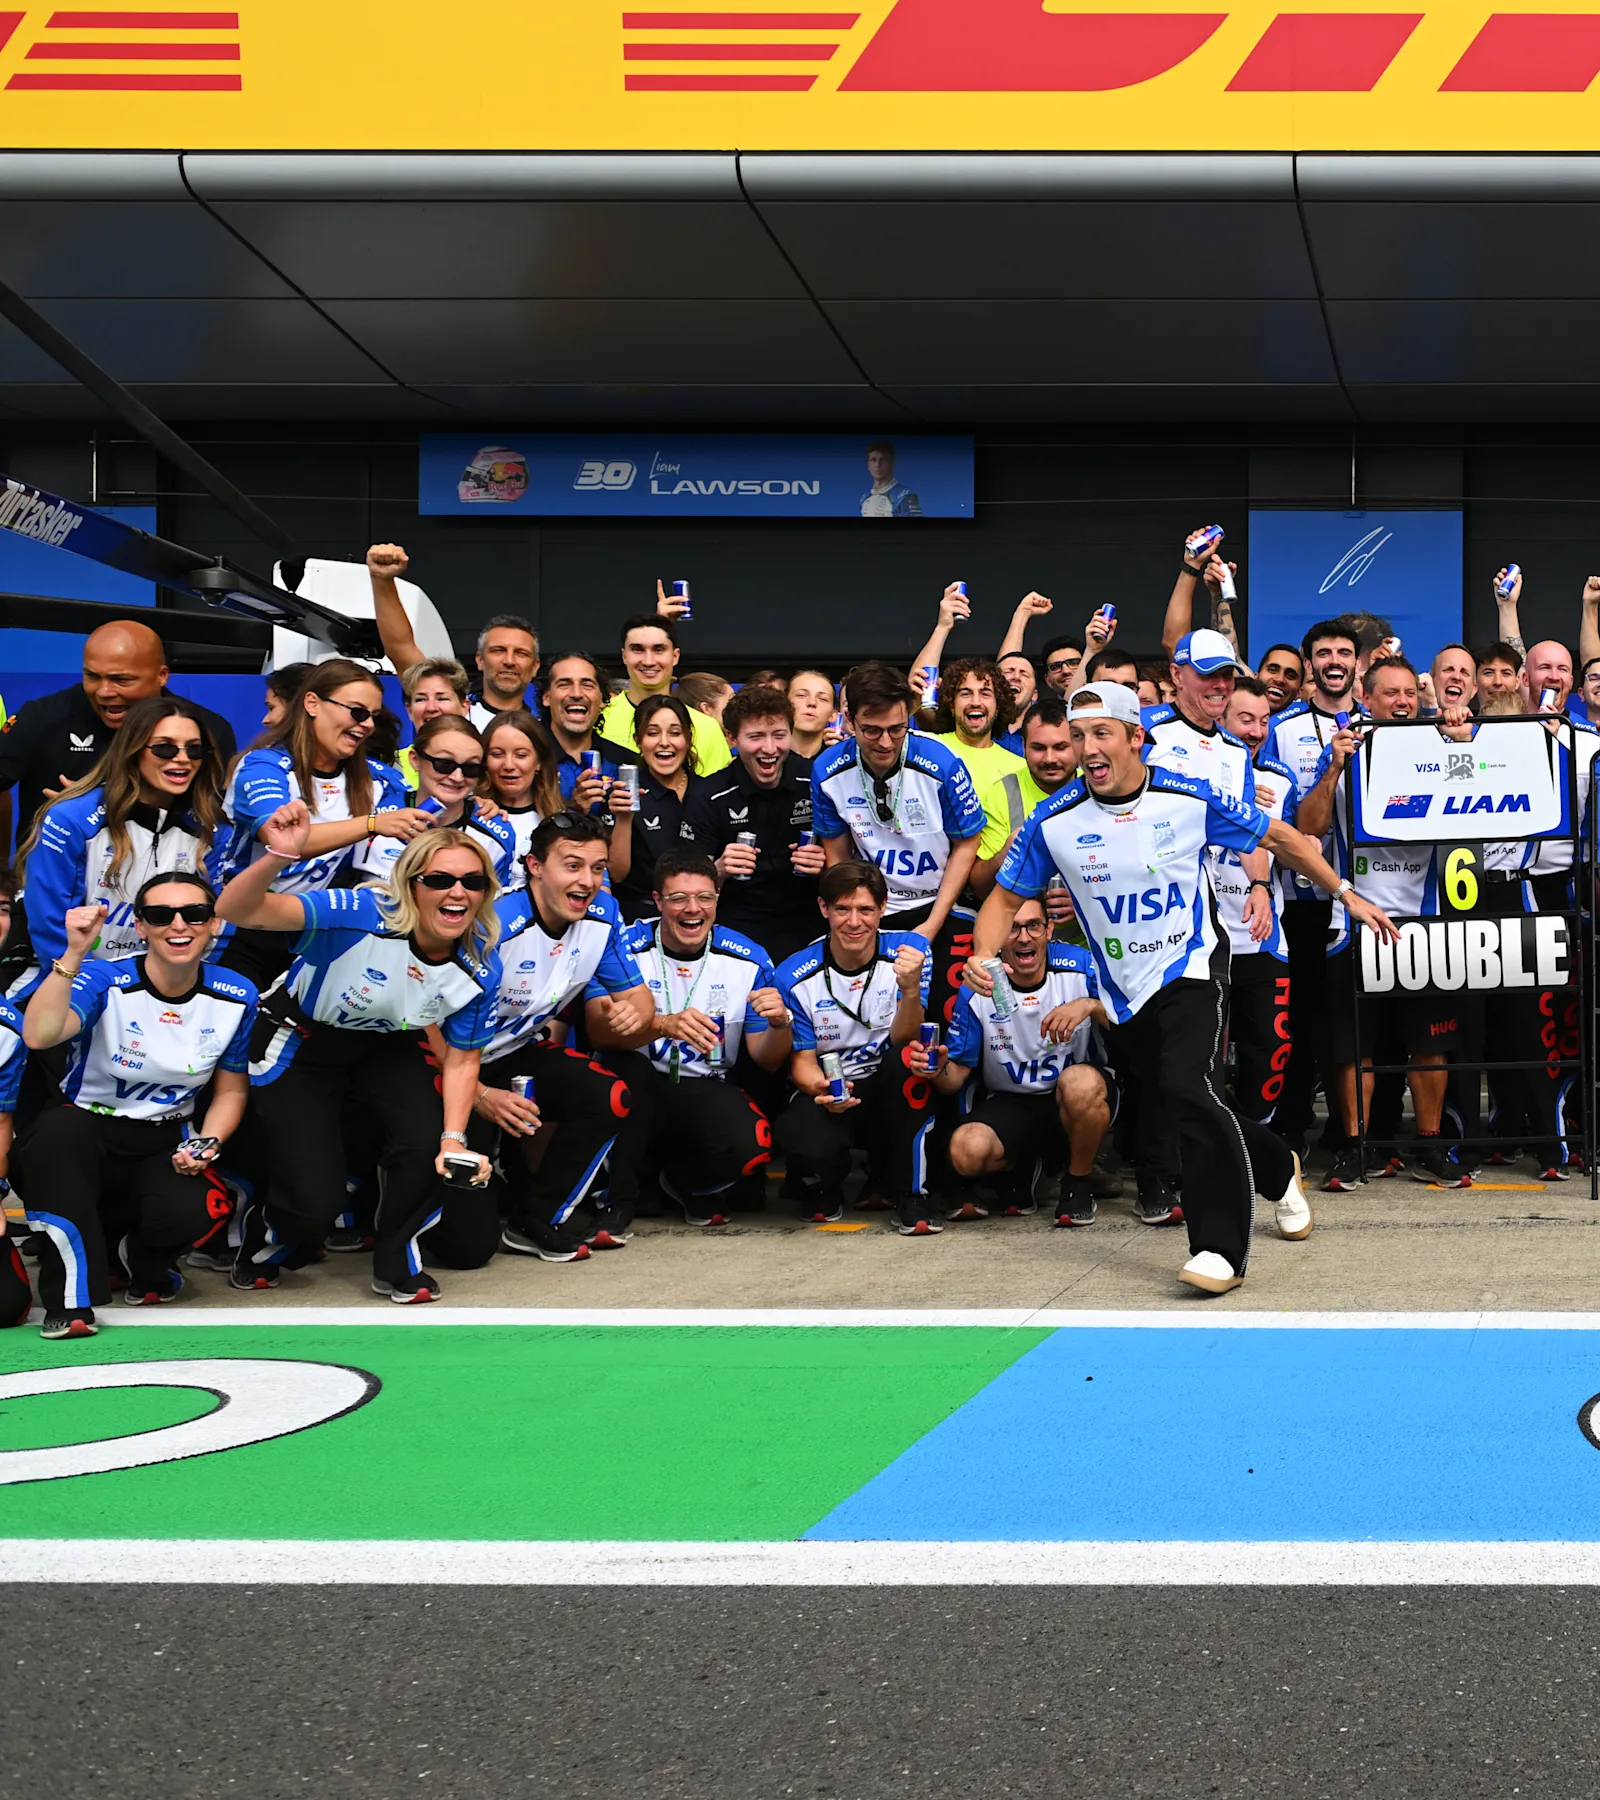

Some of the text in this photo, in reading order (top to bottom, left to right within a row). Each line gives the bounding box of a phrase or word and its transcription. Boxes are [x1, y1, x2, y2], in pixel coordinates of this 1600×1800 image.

[647, 451, 681, 478] Liam
[573, 460, 637, 491] 30
[651, 480, 820, 496] LAWSON
[1150, 710, 1169, 722] HUGO
[1277, 707, 1301, 720] HUGO
[826, 753, 851, 774] HUGO
[913, 754, 939, 772] HUGO
[1264, 760, 1289, 774] HUGO
[1414, 763, 1441, 773] VISA
[1162, 778, 1198, 792] HUGO
[1048, 788, 1079, 811] HUGO
[1442, 794, 1531, 815] LIAM
[478, 815, 509, 840] HUGO
[1153, 821, 1171, 830] VISA
[854, 830, 873, 839] obil
[1080, 862, 1108, 872] TUDOR
[1372, 861, 1421, 874] Cash App
[1083, 873, 1112, 884] Mobil
[1444, 847, 1480, 912] 6
[890, 887, 918, 898] Cash
[1214, 882, 1242, 894] Cash
[588, 904, 605, 916] GO
[1092, 882, 1187, 924] VISA
[105, 940, 136, 951] Cash
[721, 938, 751, 956] HUGO
[1128, 940, 1163, 954] Cash
[1360, 915, 1569, 993] DOUBLE
[462, 953, 489, 978] HUGO
[792, 958, 818, 978] HUGO
[212, 981, 247, 997] HUGO
[348, 986, 373, 1004] TUDOR
[340, 992, 367, 1013] Mobil
[500, 996, 530, 1007] Mobil
[170, 1018, 183, 1026] Bull
[336, 1005, 395, 1033] VIS
[1430, 1018, 1457, 1037] HUG
[816, 1033, 841, 1042] Mobil
[118, 1044, 147, 1059] TUDOR
[990, 1043, 1014, 1051] Mobil
[111, 1053, 143, 1070] Mobil
